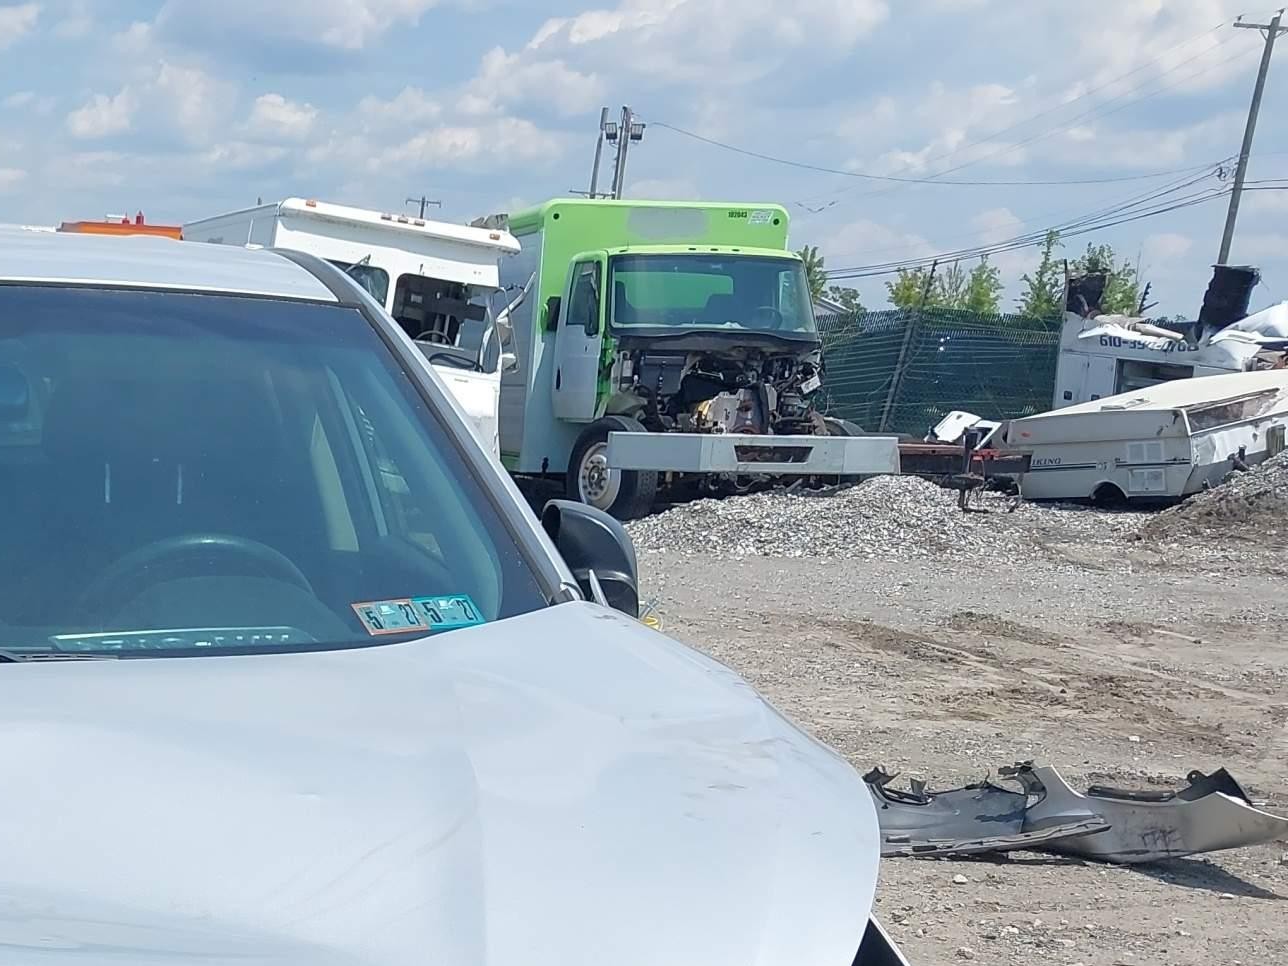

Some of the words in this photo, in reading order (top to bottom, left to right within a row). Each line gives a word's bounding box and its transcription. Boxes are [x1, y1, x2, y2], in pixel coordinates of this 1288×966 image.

[365, 611, 384, 630] 5
[398, 603, 421, 626] 27
[420, 601, 443, 624] 5
[455, 599, 479, 621] 27
